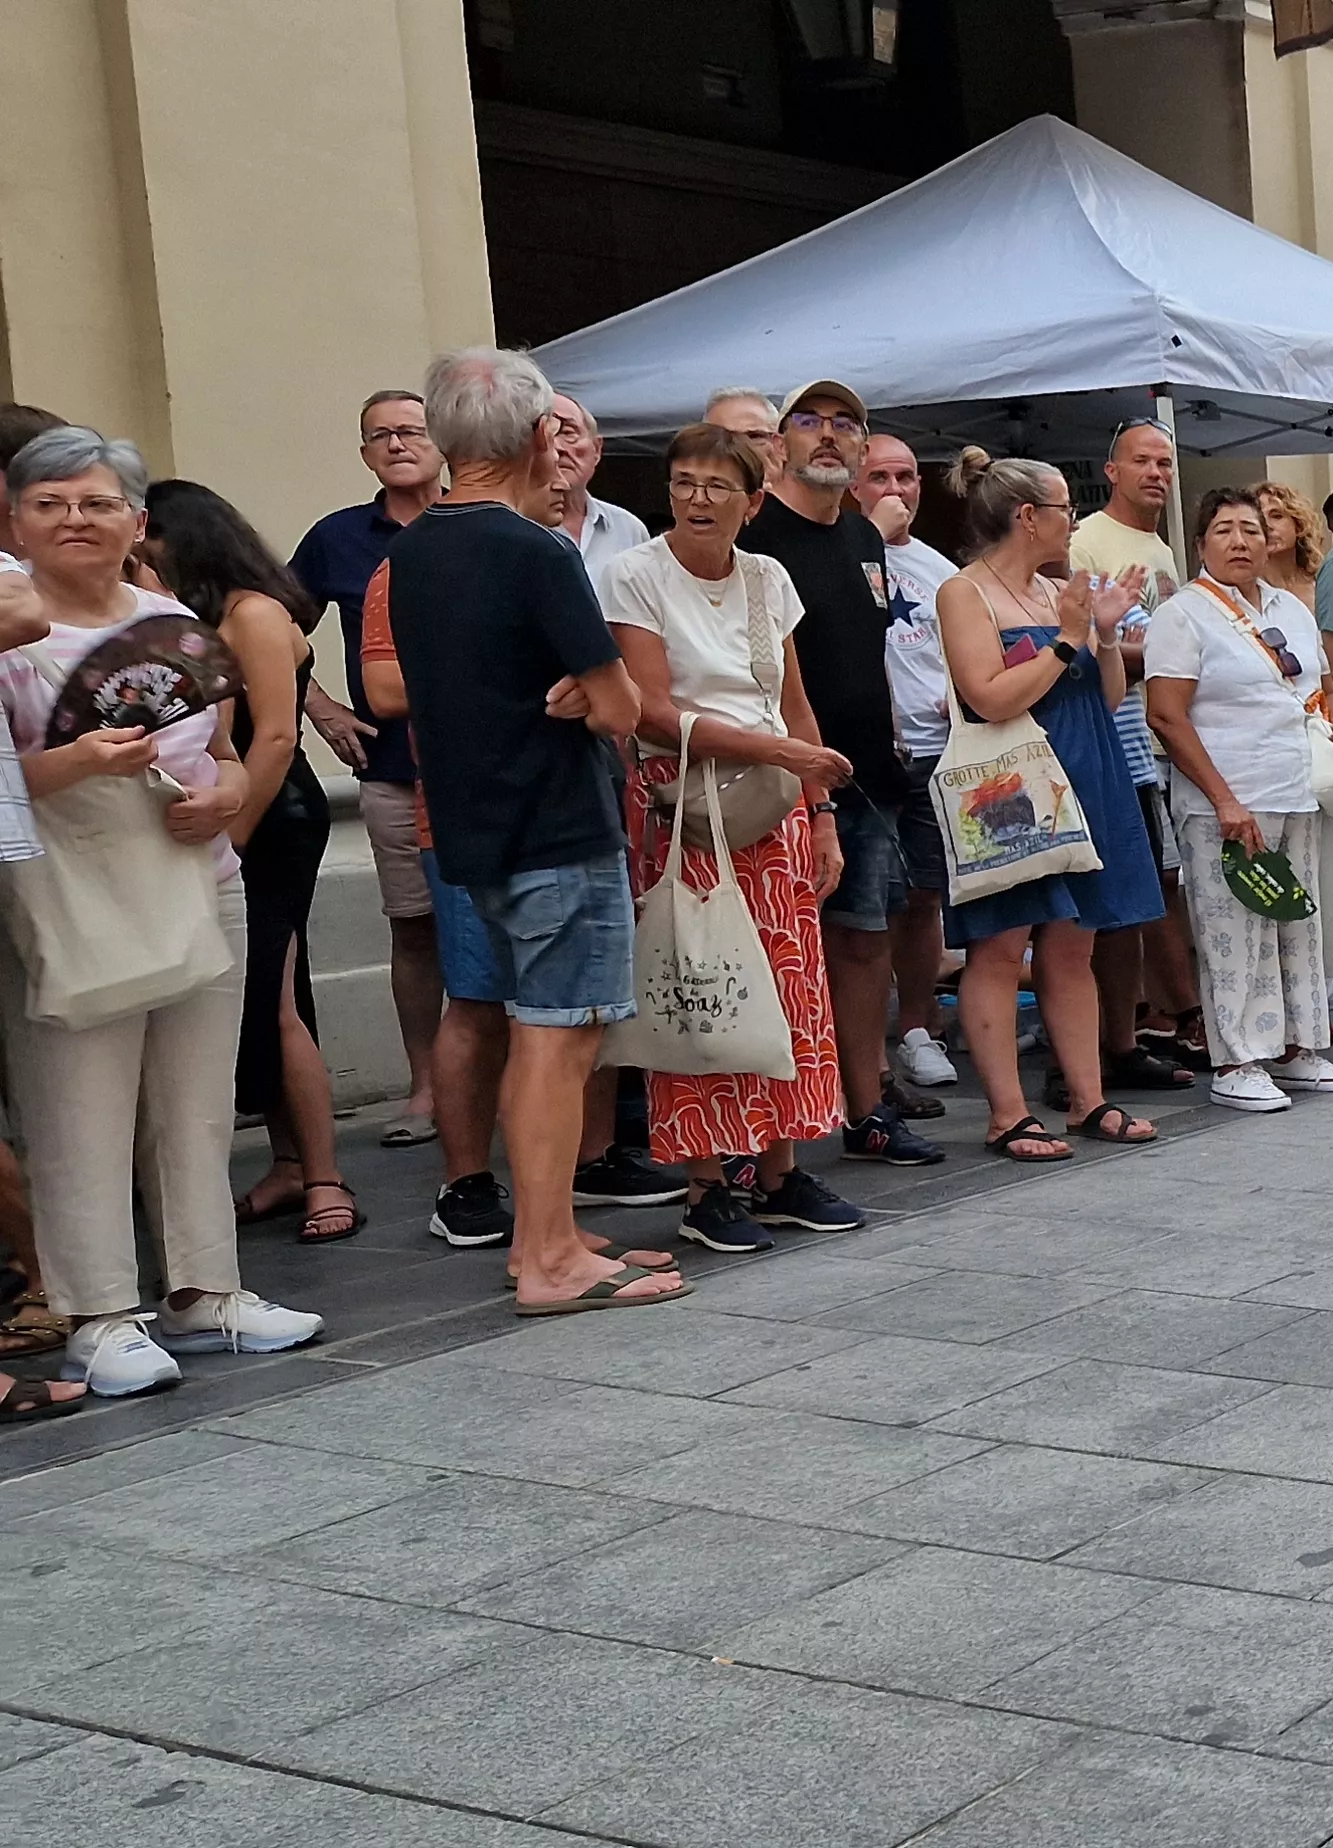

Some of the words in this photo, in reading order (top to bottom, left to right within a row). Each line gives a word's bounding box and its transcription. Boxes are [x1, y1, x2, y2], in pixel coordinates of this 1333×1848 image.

[898, 627, 927, 643] STAR
[943, 766, 989, 787] GROTTE
[1027, 744, 1054, 762] AZIL
